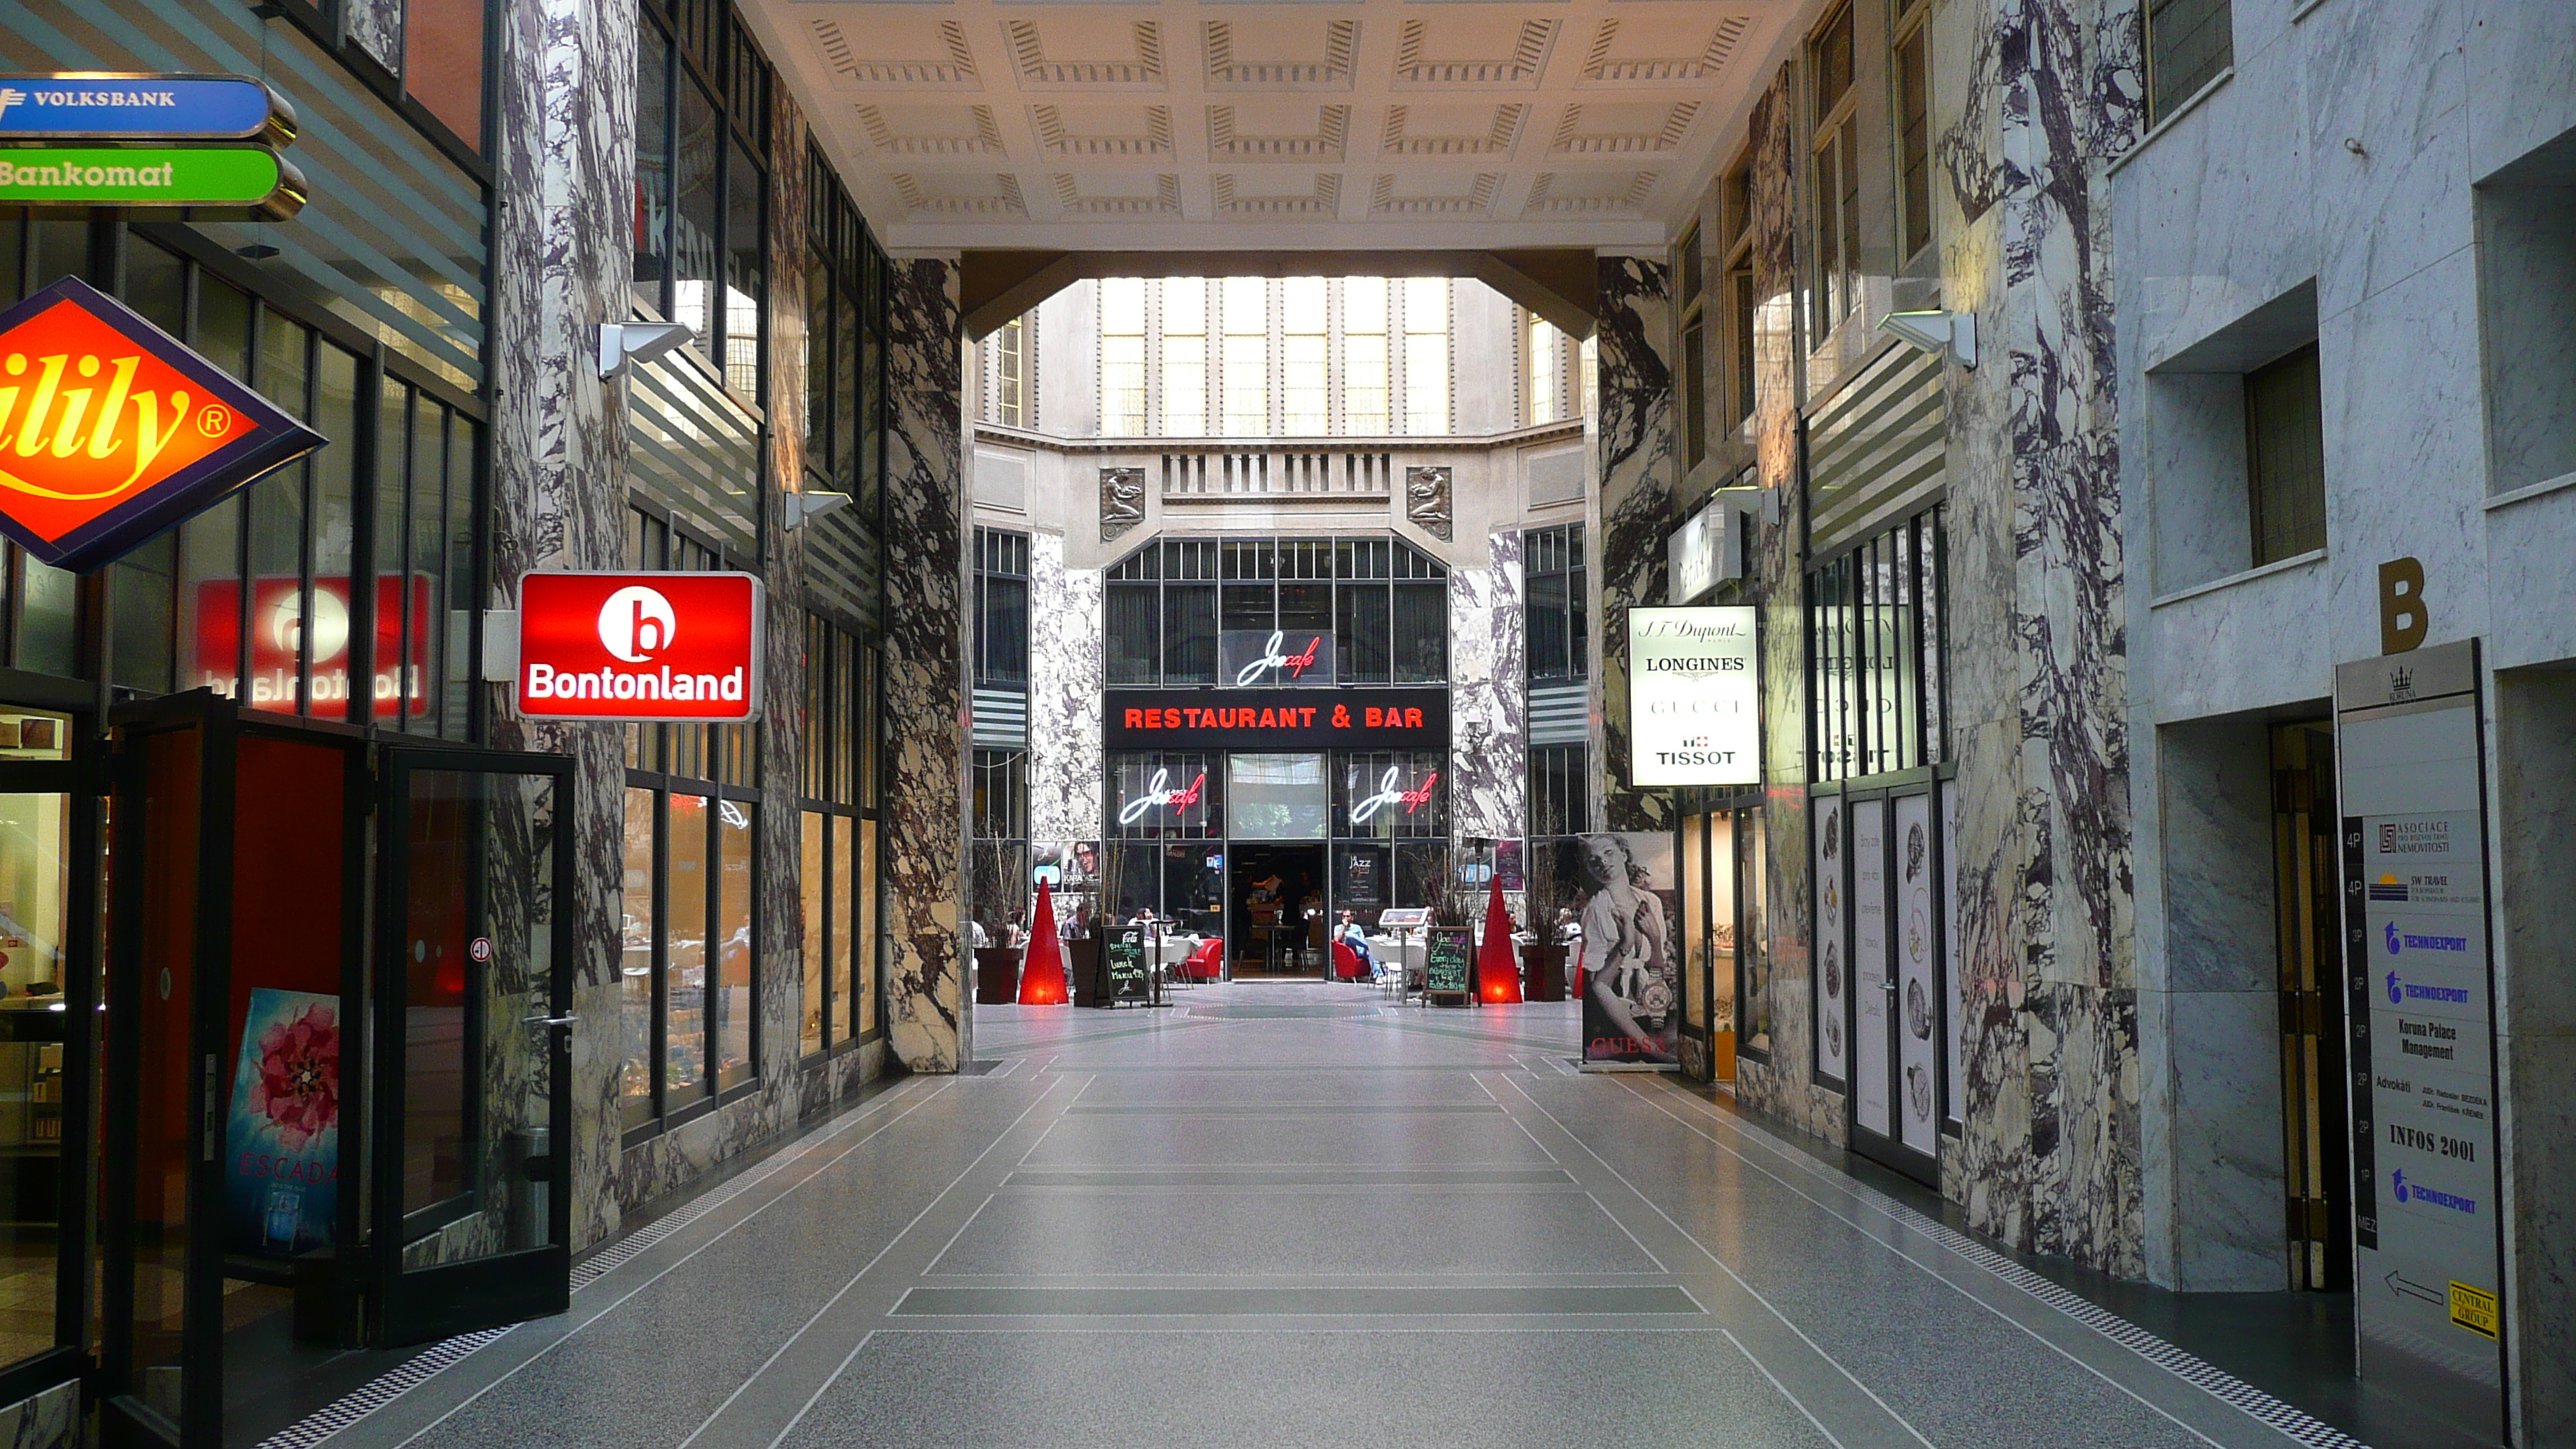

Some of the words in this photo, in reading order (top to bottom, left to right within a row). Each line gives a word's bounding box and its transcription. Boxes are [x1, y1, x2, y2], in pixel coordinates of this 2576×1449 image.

[34, 91, 176, 107] VOLKSBANK
[0, 161, 173, 187] Bankomat
[2378, 557, 2428, 656] B
[1674, 619, 1746, 643] Dupont
[1646, 657, 1744, 671] LONGINES
[528, 663, 743, 701] Bontonland
[1125, 707, 1316, 729] RESTAURANT
[1331, 704, 1351, 728] &
[1365, 707, 1423, 728] BAR
[1656, 751, 1735, 766] TISSOT
[2397, 821, 2448, 834] ASOCIACE
[2347, 832, 2361, 848] 4P
[2348, 880, 2362, 896] 4P
[2411, 876, 2422, 886] SW
[2424, 875, 2448, 886] TRAVEL
[2403, 934, 2467, 952] TECHNOEXPORT
[1110, 957, 1134, 970] Lunch
[2354, 977, 2364, 991] 2P
[2404, 984, 2469, 1004] TECHNOEXPORT
[2355, 1024, 2366, 1038] 2P
[2399, 1019, 2427, 1037] Koruna
[2429, 1022, 2457, 1040] Palace
[1591, 1037, 1667, 1053] GUESS
[2402, 1038, 2454, 1060] Management
[2357, 1072, 2368, 1086] 2P
[2376, 1075, 2411, 1093] Advokáti
[2358, 1120, 2369, 1134] 2P
[2389, 1124, 2435, 1153] INFOS
[2440, 1136, 2475, 1163] 2001
[239, 1151, 338, 1187] ESCADA
[2411, 1184, 2476, 1215] TECHNOEXPORT
[2452, 1289, 2494, 1314] CENTRAL
[2458, 1307, 2489, 1327] GROUP
